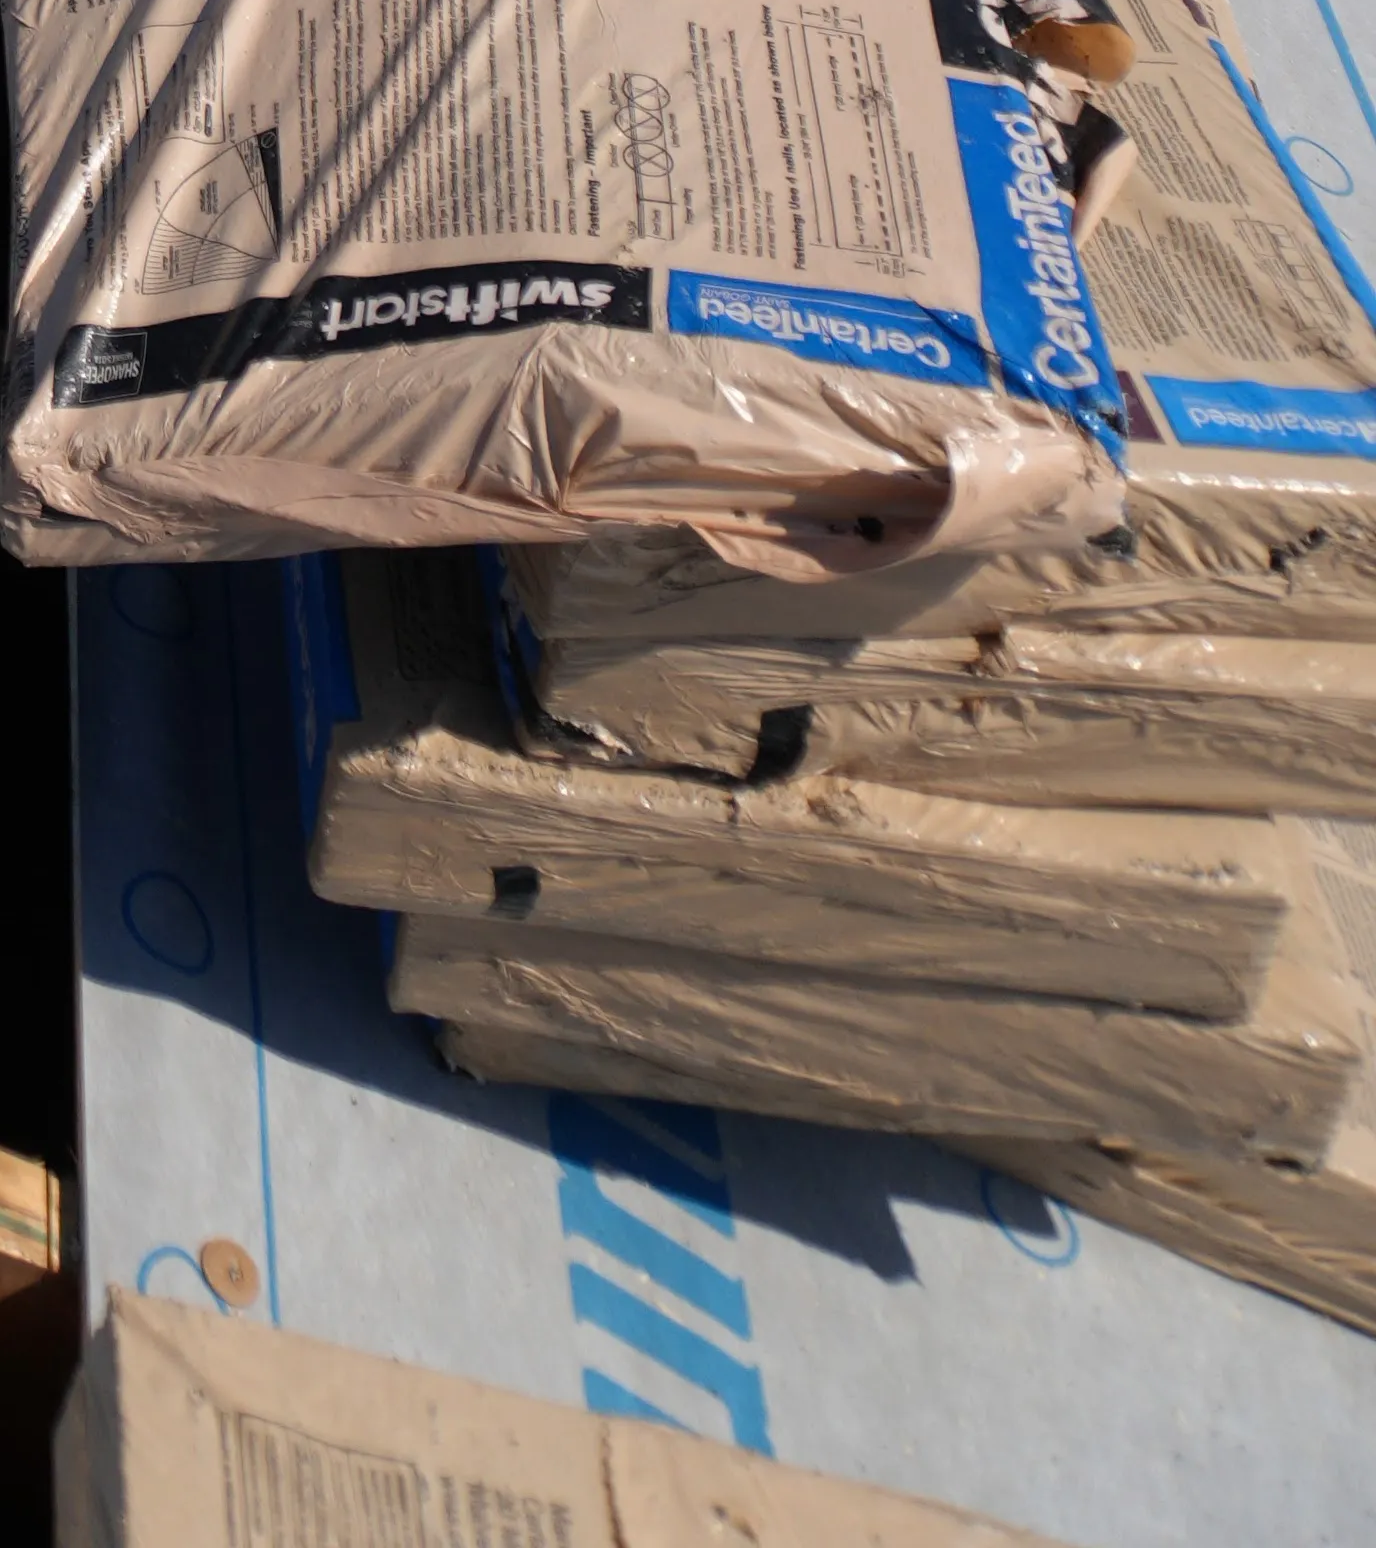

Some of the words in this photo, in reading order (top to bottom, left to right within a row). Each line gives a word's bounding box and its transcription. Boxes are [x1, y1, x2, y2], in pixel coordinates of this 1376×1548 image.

[761, 5, 777, 39] below
[767, 41, 784, 77] shown
[581, 109, 597, 166] Important
[773, 95, 792, 140] located
[780, 143, 796, 173] nails,
[586, 180, 601, 237] Fastening
[787, 187, 803, 210] Use
[789, 213, 806, 270] Fastening:
[996, 112, 1099, 391] CertainTeed
[320, 279, 616, 341] swiftstart
[698, 296, 952, 369] CertainTeed
[85, 358, 141, 384] SHAKOPEE
[1187, 407, 1356, 440] certainteed
